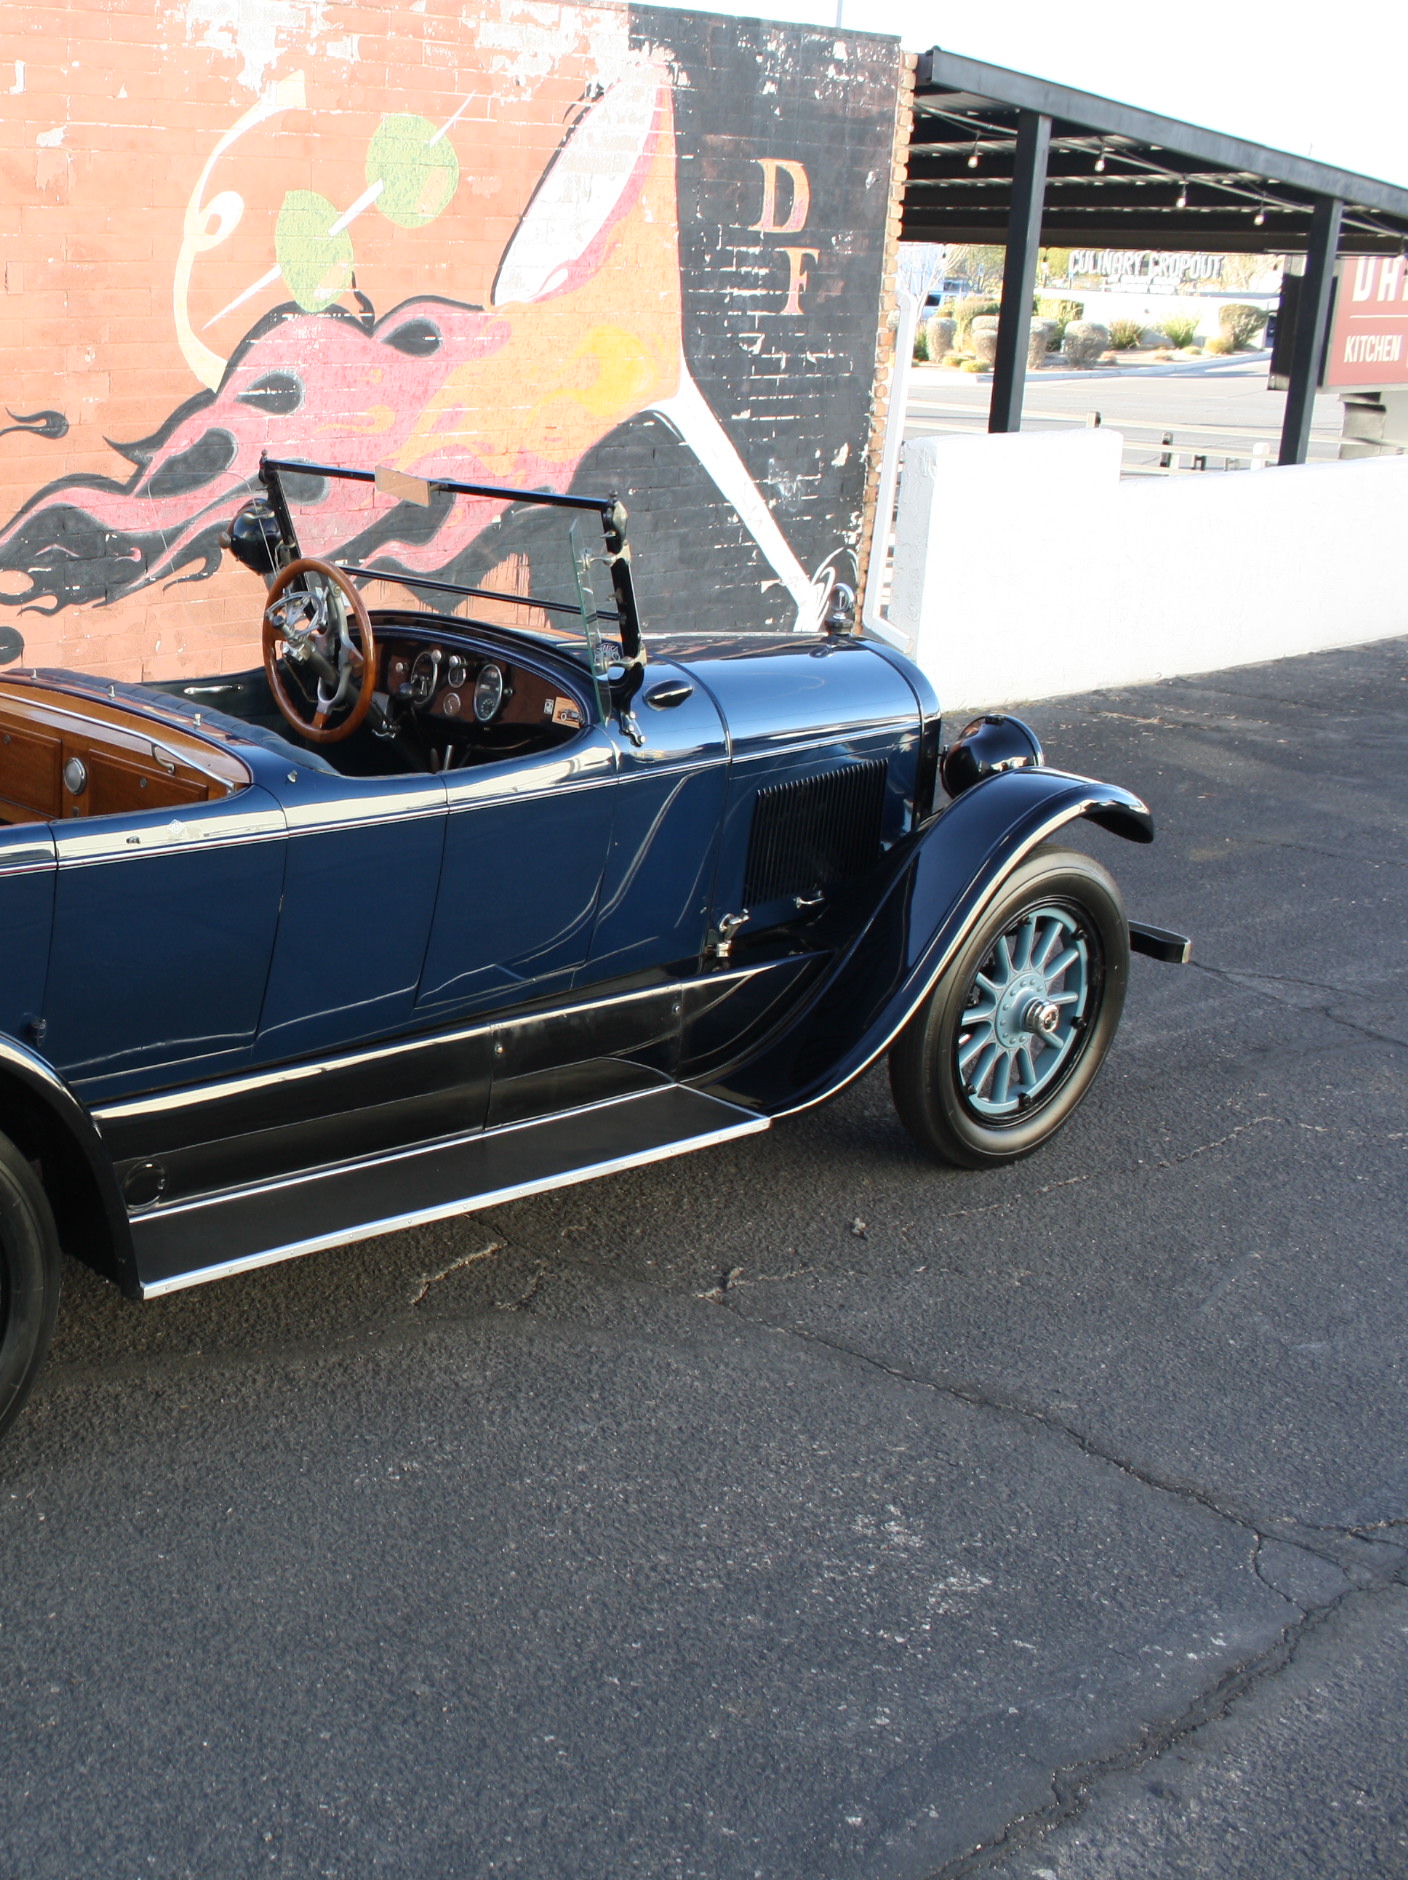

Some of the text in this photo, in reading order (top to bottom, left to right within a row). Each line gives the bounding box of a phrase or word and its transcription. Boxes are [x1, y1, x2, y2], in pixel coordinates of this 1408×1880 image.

[748, 157, 811, 233] D
[777, 246, 821, 316] F
[1069, 249, 1149, 276] CULINARY
[1343, 335, 1402, 363] KITCHEN
